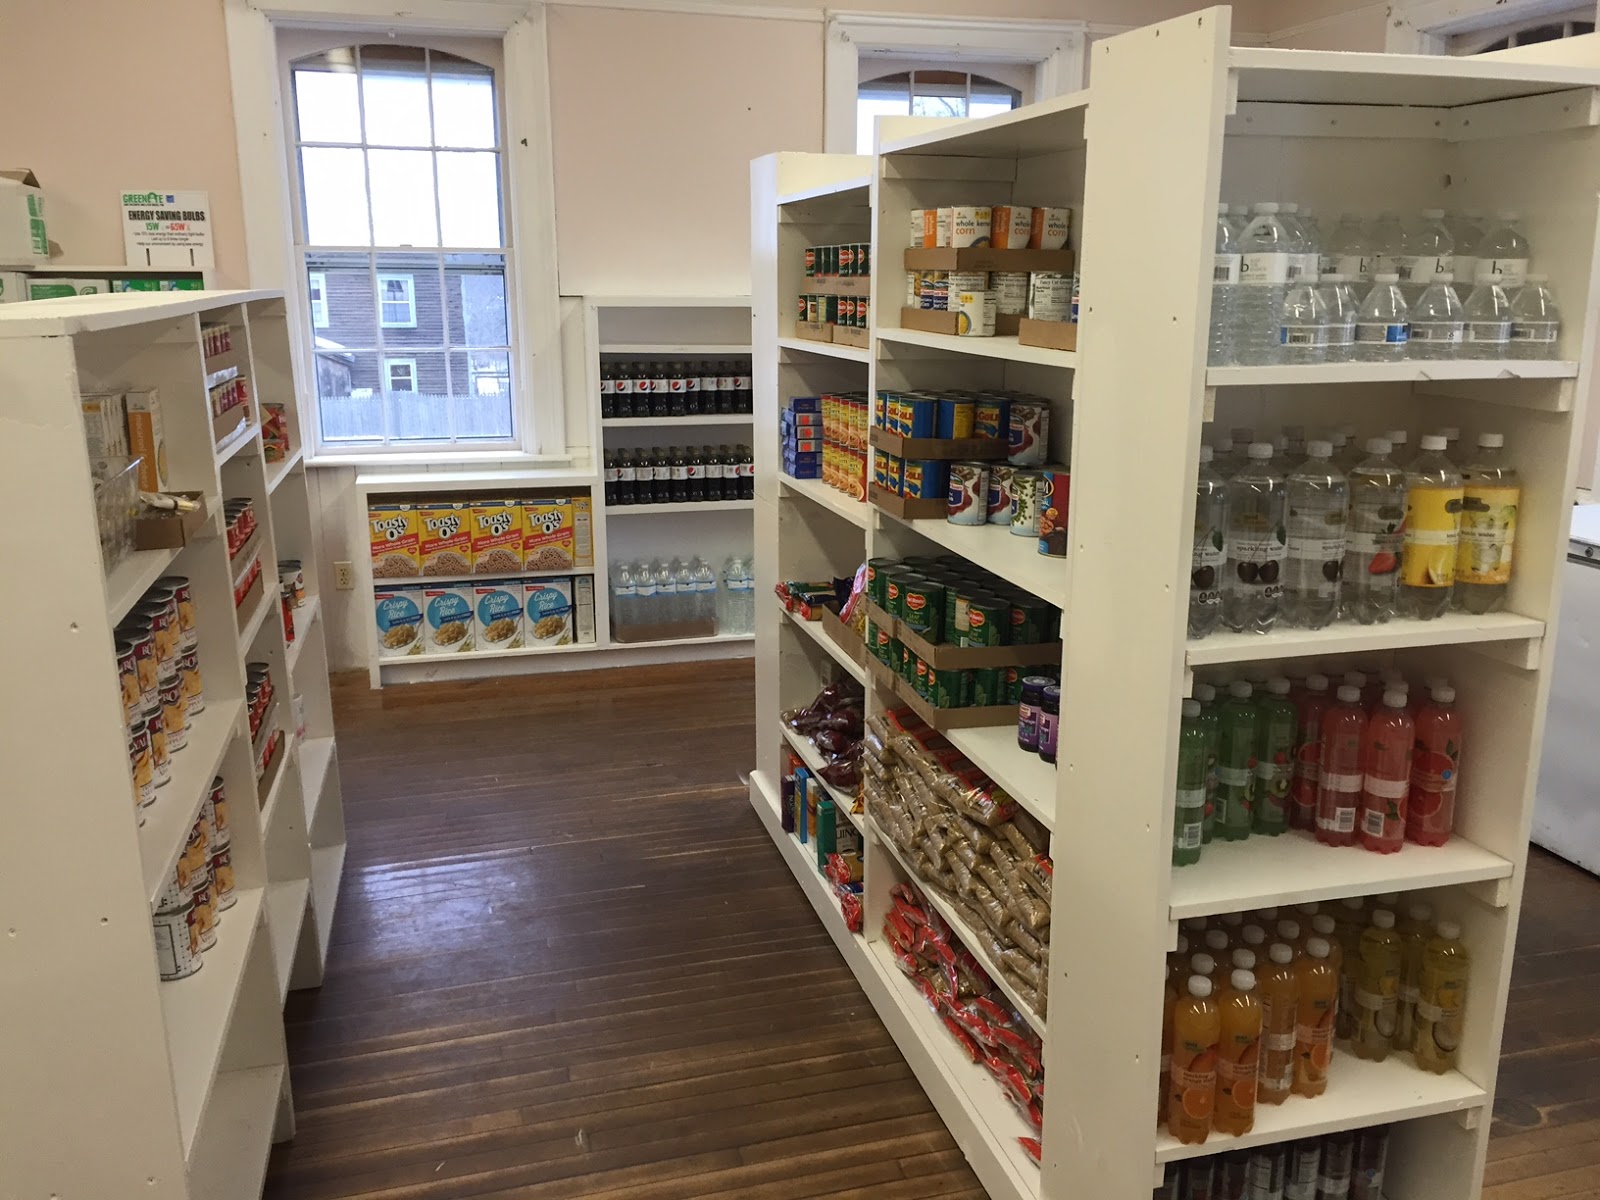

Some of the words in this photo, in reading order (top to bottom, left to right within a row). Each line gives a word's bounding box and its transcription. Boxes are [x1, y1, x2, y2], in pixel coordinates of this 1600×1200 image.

[128, 210, 154, 221] ENERGY
[155, 210, 181, 221] SAVING
[182, 211, 205, 221] BULBS
[145, 222, 160, 231] 15W
[170, 223, 186, 231] 65W
[1240, 255, 1249, 273] b
[424, 513, 461, 532] Toasty
[476, 510, 513, 529] Toasty
[528, 508, 564, 527] Toasty
[370, 514, 409, 533] Toasty
[490, 522, 509, 536] O's
[542, 520, 560, 535] O's
[386, 526, 405, 541] O's
[438, 525, 457, 540] O's
[434, 597, 460, 607] Crispy
[484, 594, 510, 605] Crispy
[533, 591, 558, 602] Crispy
[382, 600, 409, 611] Crispy
[489, 603, 506, 613] Rice
[538, 600, 555, 611] Rice
[388, 609, 405, 620] Rice
[439, 606, 456, 617] Rice
